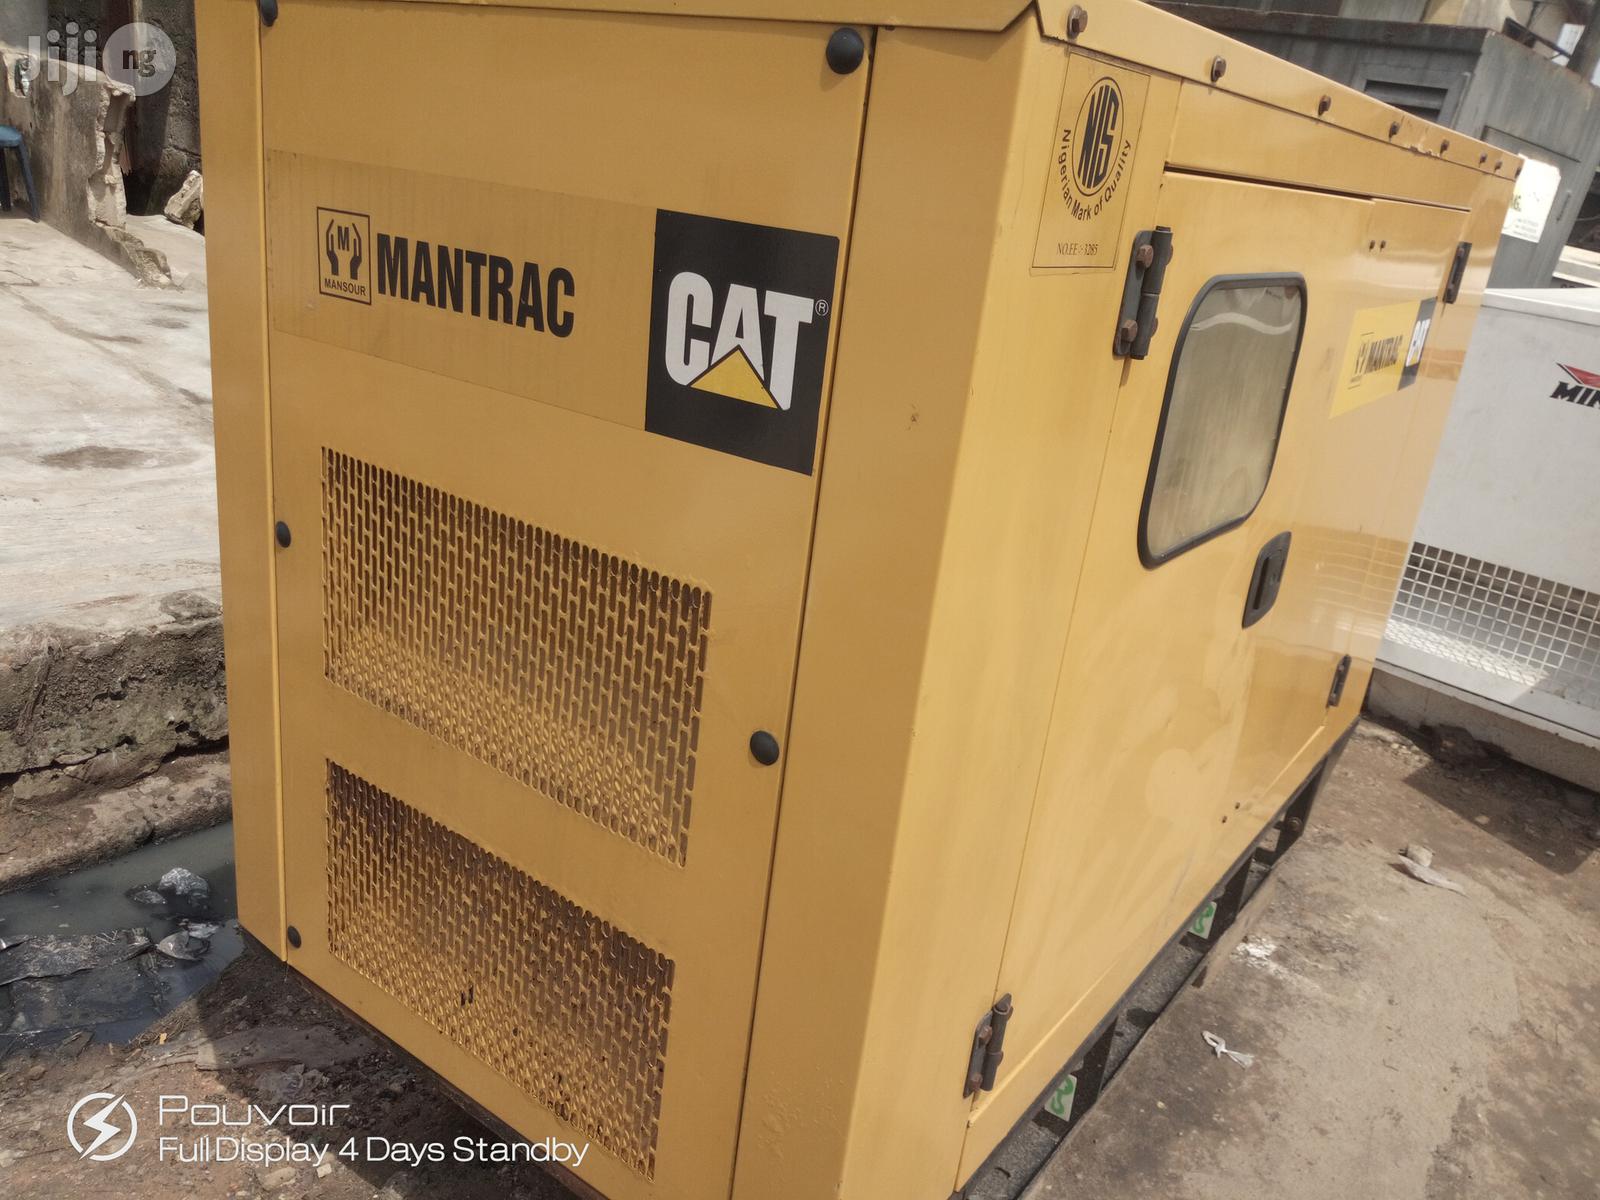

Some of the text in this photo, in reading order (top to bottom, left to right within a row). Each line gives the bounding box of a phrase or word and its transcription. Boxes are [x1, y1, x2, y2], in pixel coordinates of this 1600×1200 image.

[1058, 128, 1132, 222] Nigerian Mark of Quality
[1077, 84, 1121, 190] NIS
[324, 277, 366, 297] MANSOUR
[376, 232, 576, 339] MANTRAC
